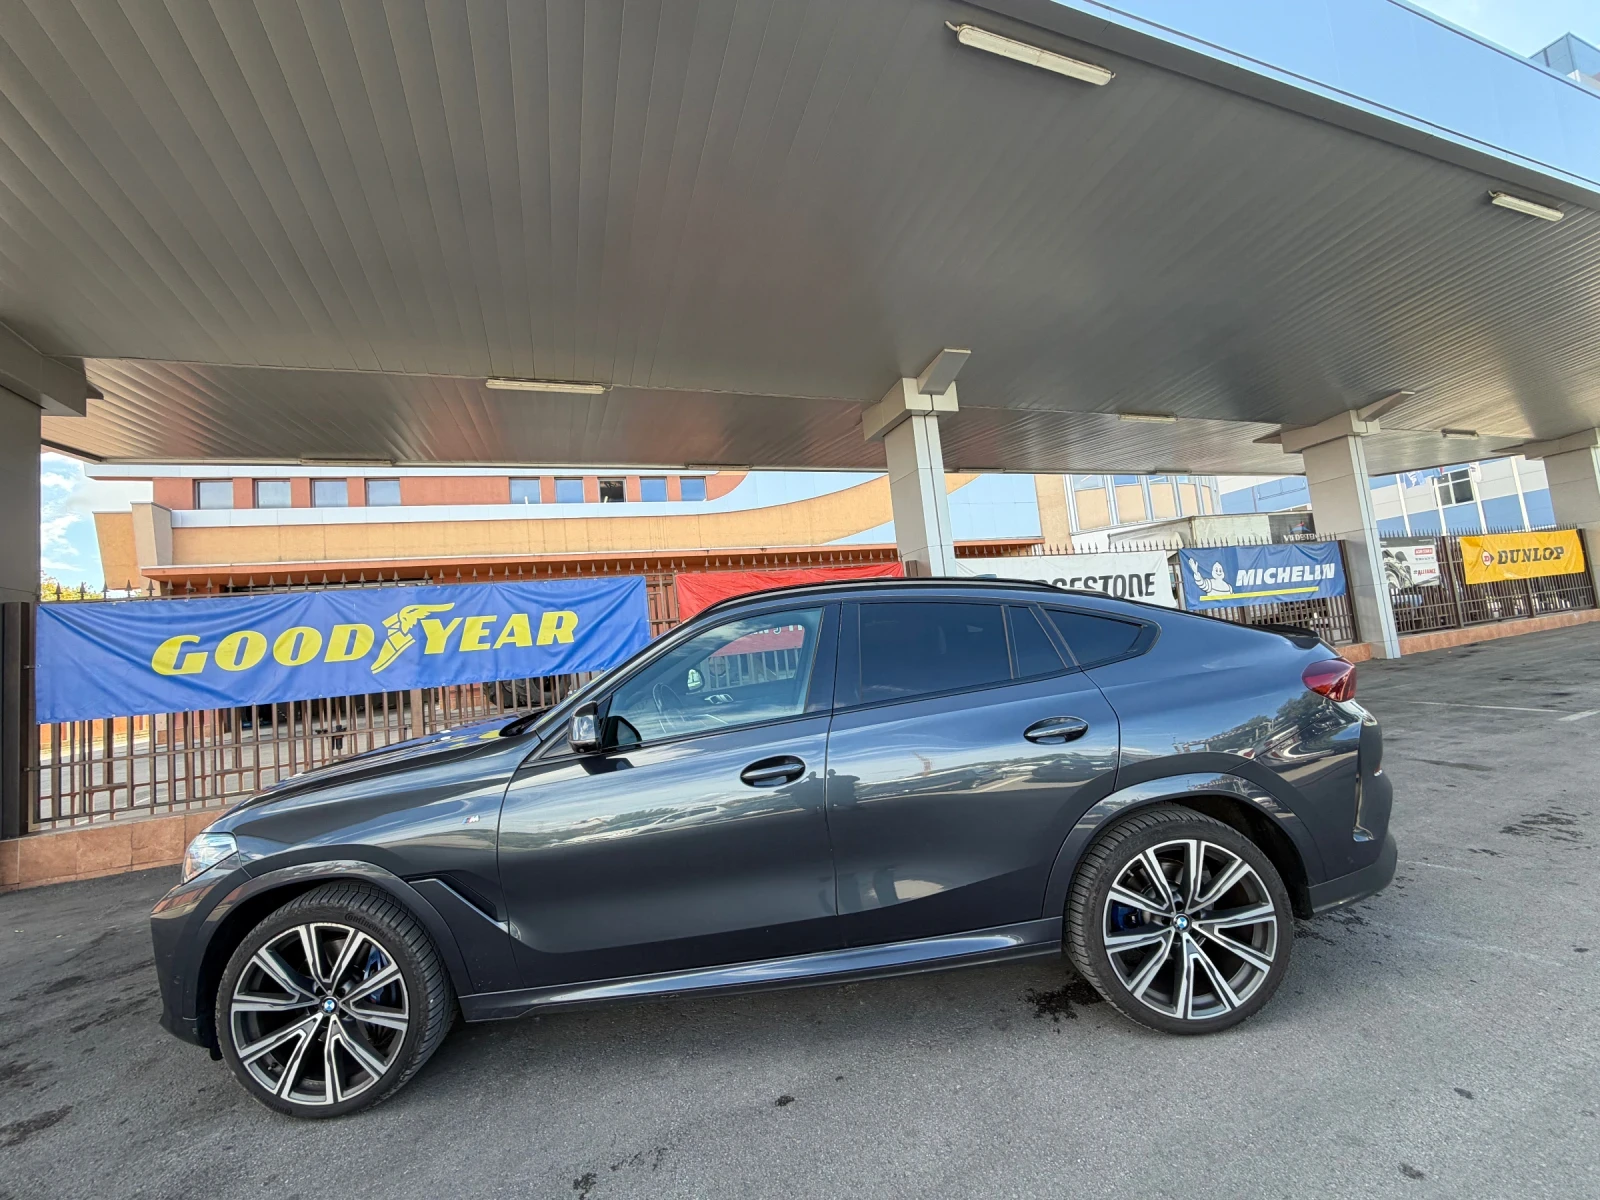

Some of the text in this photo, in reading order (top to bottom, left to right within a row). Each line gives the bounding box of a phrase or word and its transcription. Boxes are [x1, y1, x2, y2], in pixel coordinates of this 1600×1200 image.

[1497, 546, 1564, 565] DUNLOP
[1235, 563, 1335, 586] MICHELIN
[345, 912, 387, 939] Continental
